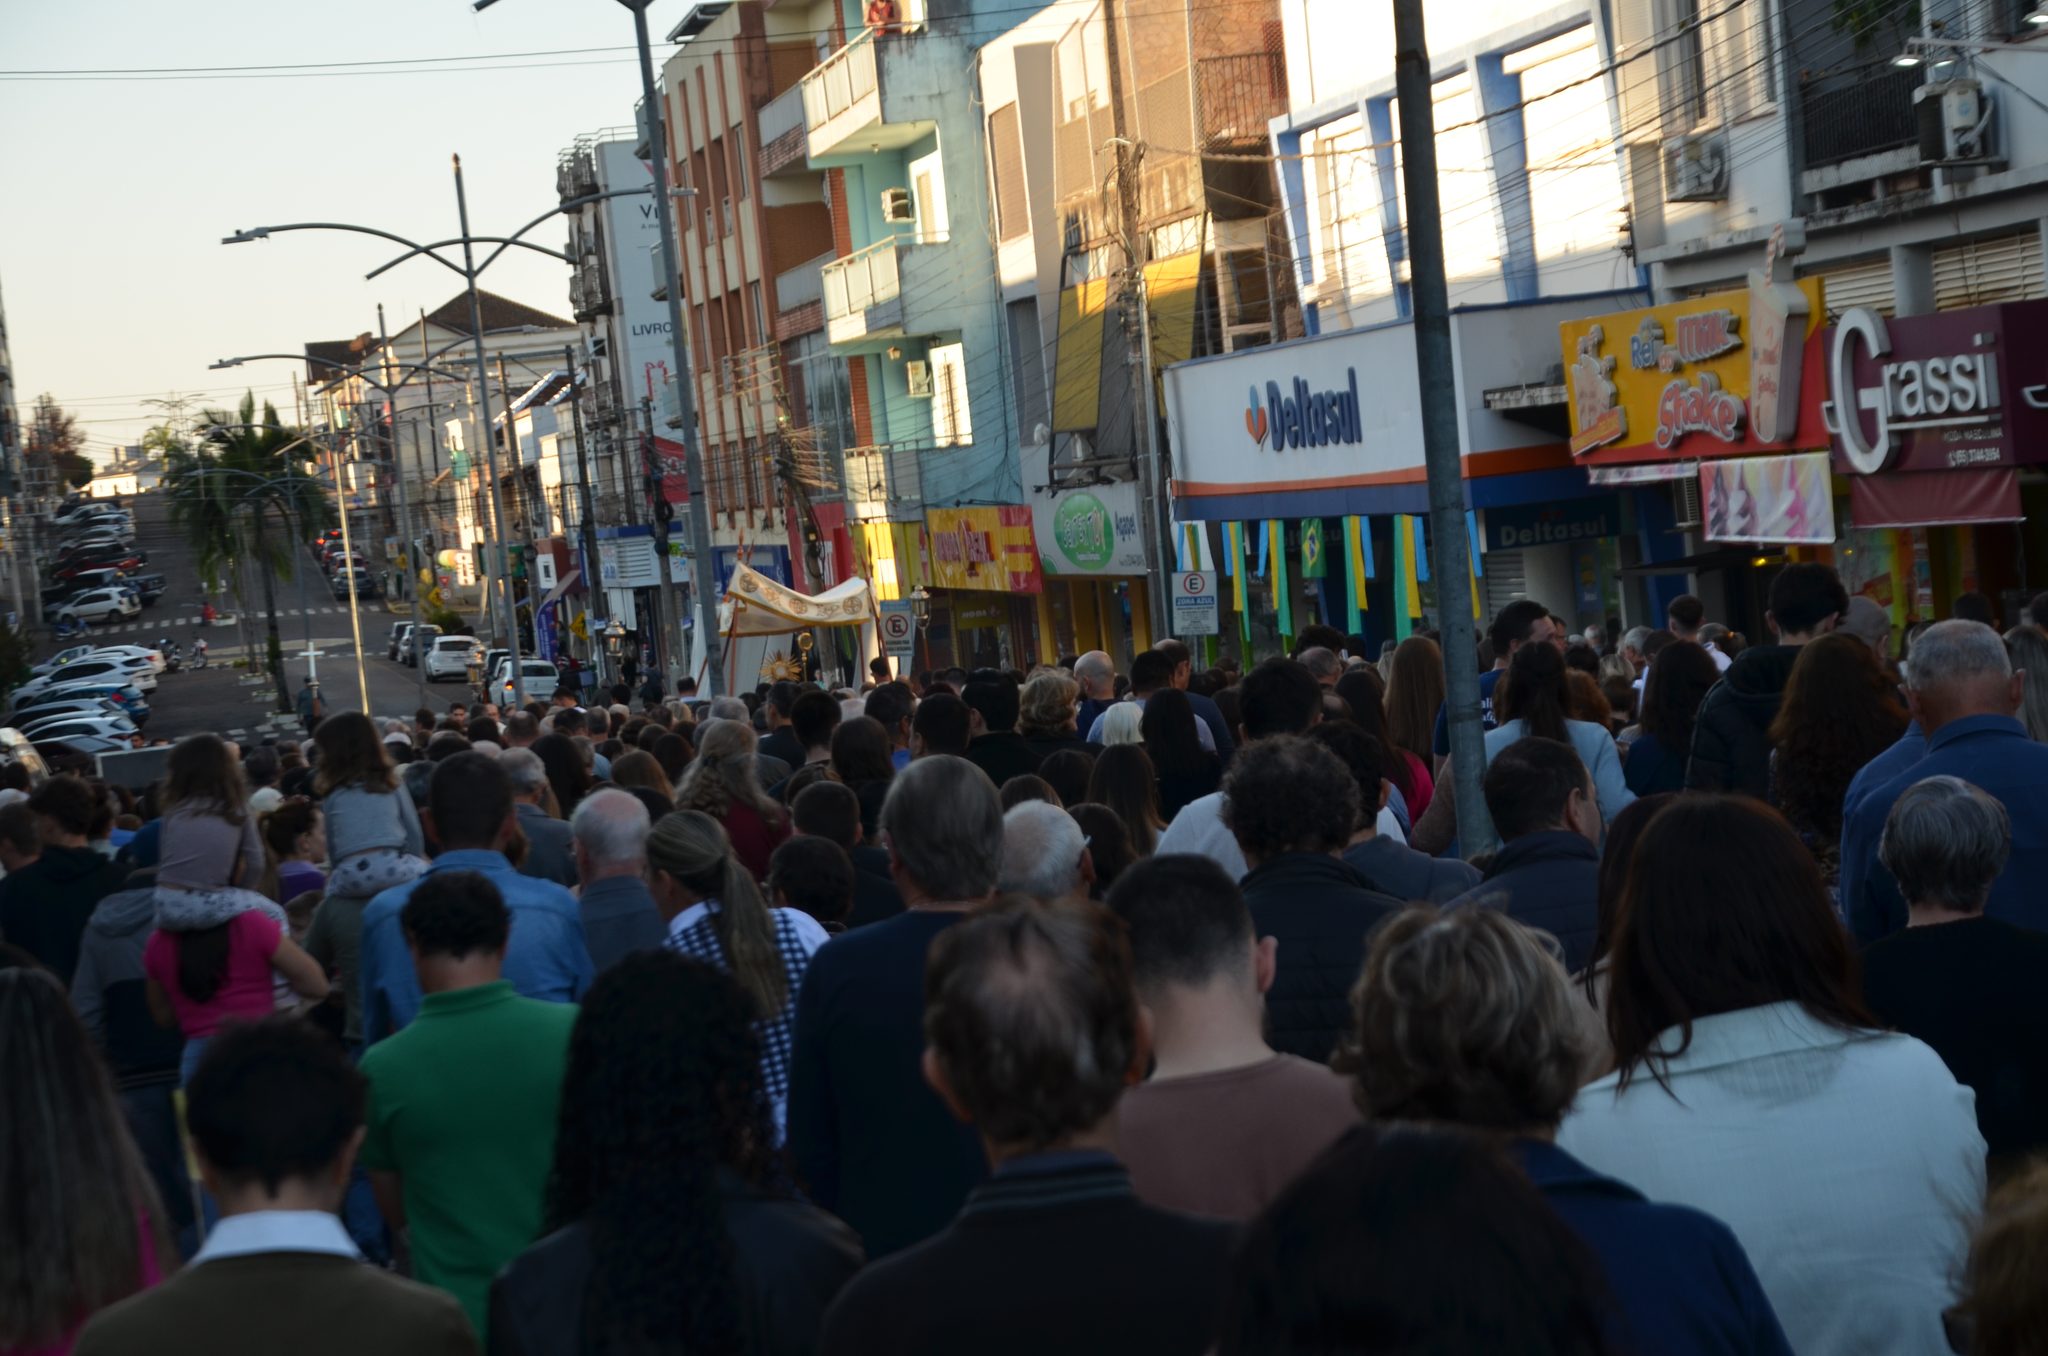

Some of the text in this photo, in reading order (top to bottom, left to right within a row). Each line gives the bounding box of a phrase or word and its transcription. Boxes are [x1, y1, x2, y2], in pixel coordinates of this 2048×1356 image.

[632, 322, 673, 336] LIVRO
[1266, 366, 1362, 452] Deltasul
[1656, 372, 1738, 449] Shake
[1831, 307, 1995, 475] Grassi
[1501, 513, 1607, 547] Deltasul
[1189, 577, 1199, 590] E
